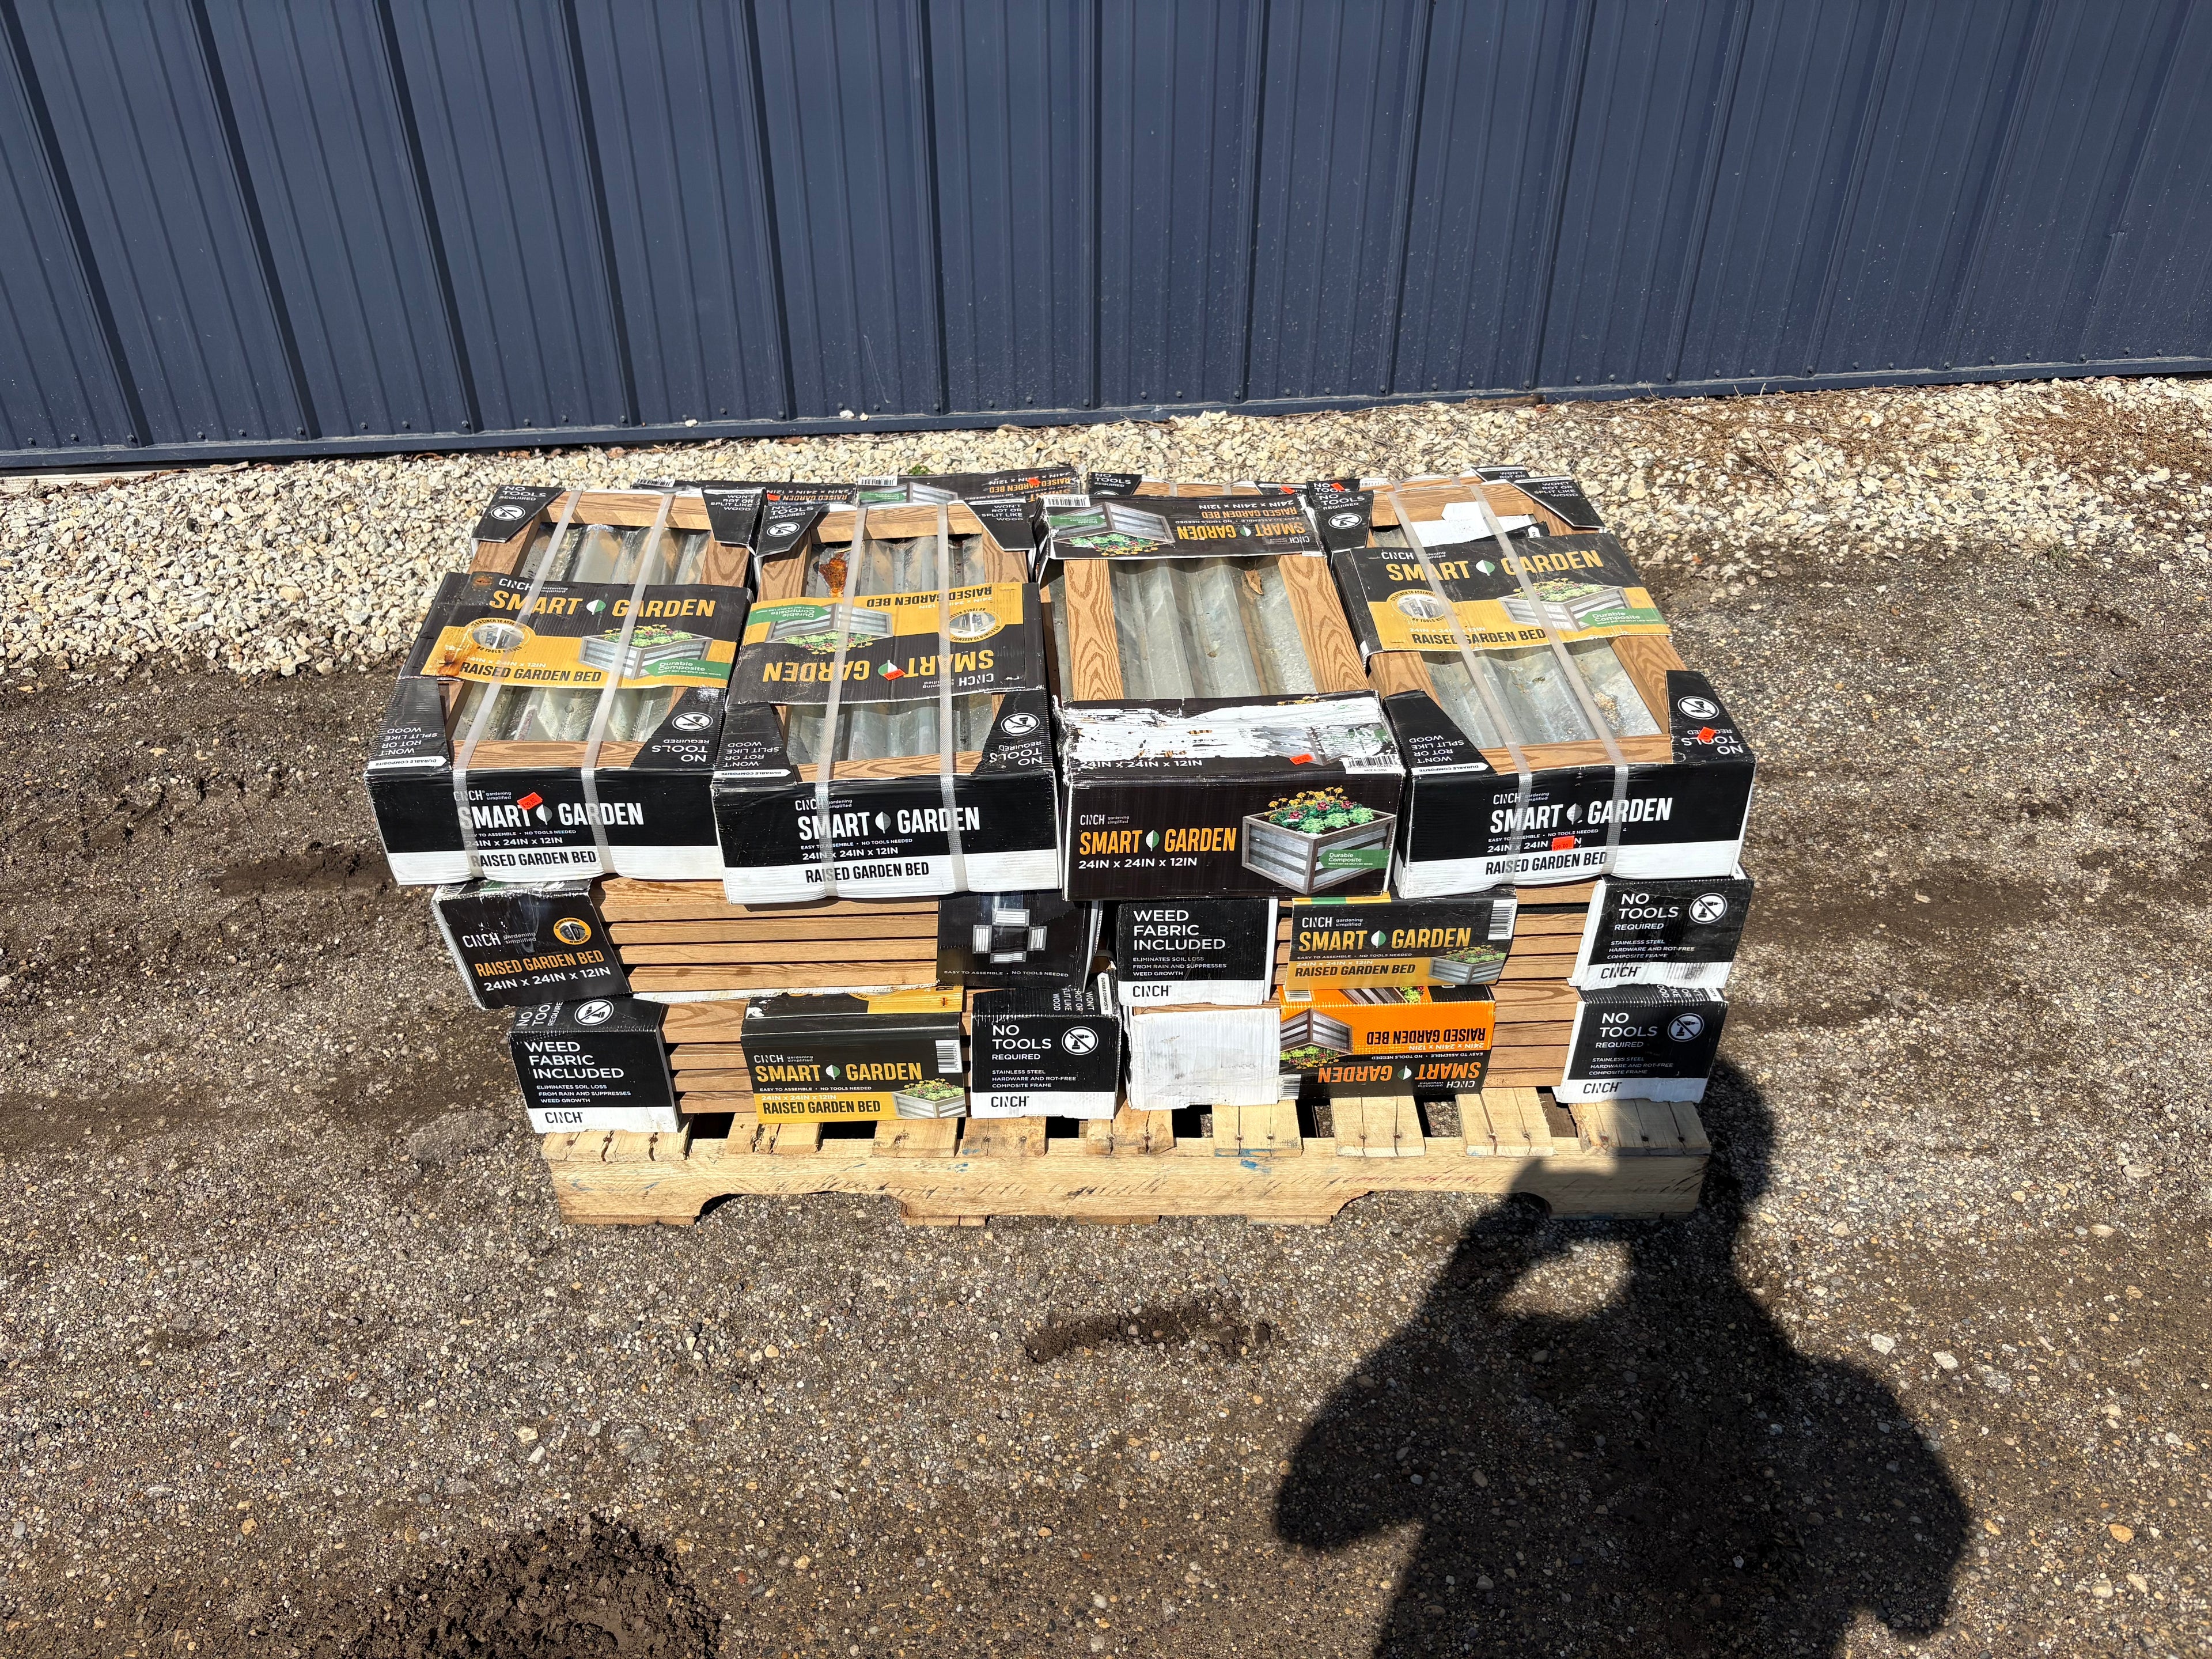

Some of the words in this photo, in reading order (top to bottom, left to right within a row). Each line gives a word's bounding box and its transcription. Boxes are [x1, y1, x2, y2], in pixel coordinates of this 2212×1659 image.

[1321, 496, 1365, 506] TOOLS
[1263, 507, 1297, 517] RAISED
[1177, 525, 1236, 539] GARDEN
[1255, 522, 1305, 537] SMART
[1381, 552, 1414, 560] CINCH
[460, 662, 511, 677] RAISED
[513, 669, 570, 681] GARDEN
[573, 671, 601, 682] BED
[959, 673, 994, 687] CINCH
[797, 812, 870, 840] SMART
[897, 807, 980, 834] GARDEN
[1080, 815, 1104, 825] CINCH
[1080, 830, 1143, 855] SMART
[1164, 828, 1237, 853] GARDEN
[471, 854, 516, 867] RAISED
[518, 853, 568, 865] GARDEN
[574, 851, 596, 863] BED
[1078, 859, 1109, 869] 24IN
[1124, 858, 1154, 868] 24IN
[1170, 857, 1197, 866] 12IN
[1486, 859, 1529, 875] RAISED
[1532, 855, 1580, 870] GARDEN
[1584, 852, 1607, 865] BED
[1621, 893, 1649, 904] NO
[1134, 910, 1189, 922] WEED
[1619, 907, 1679, 919] TOOLS
[1302, 917, 1332, 927] CINCH
[1614, 923, 1664, 931] REQUIRED
[1134, 925, 1199, 936] FABRIC
[462, 934, 501, 948] CINCH
[1134, 939, 1226, 950] INCLUDED
[1298, 930, 1368, 952] SMART
[1391, 927, 1471, 949] GARDEN
[475, 960, 522, 977] RAISED
[522, 953, 577, 971] GARDEN
[576, 950, 604, 963] BED
[1295, 965, 1337, 977] RAISED
[1340, 965, 1389, 976] GARDEN
[1394, 964, 1415, 974] BED
[1600, 967, 1638, 979] CINCH
[484, 979, 517, 991] 24IN
[532, 973, 566, 984] 24IN
[580, 967, 611, 978] 12IN
[1133, 986, 1169, 997] CINCH
[1601, 1013, 1629, 1024] NO
[992, 1025, 1019, 1036] NO
[1393, 1029, 1439, 1044] GARDEN
[1444, 1028, 1486, 1043] RAISED
[1599, 1027, 1657, 1037] TOOLS
[1367, 1031, 1389, 1044] BED
[525, 1041, 580, 1052] WEED
[992, 1039, 1051, 1049] TOOLS
[529, 1055, 595, 1066] FABRIC
[532, 1069, 624, 1079] INCLUDED
[755, 1065, 820, 1082] SMART
[846, 1063, 922, 1081] GARDEN
[1318, 1065, 1393, 1083] GARDEN
[1414, 1062, 1481, 1080] SMART
[1583, 1082, 1618, 1094] CINCH
[763, 1101, 805, 1114] RAISED
[808, 1101, 854, 1113] GARDEN
[858, 1100, 881, 1112] BED
[991, 1096, 1027, 1107] CINCH
[545, 1112, 582, 1123] CINCH
